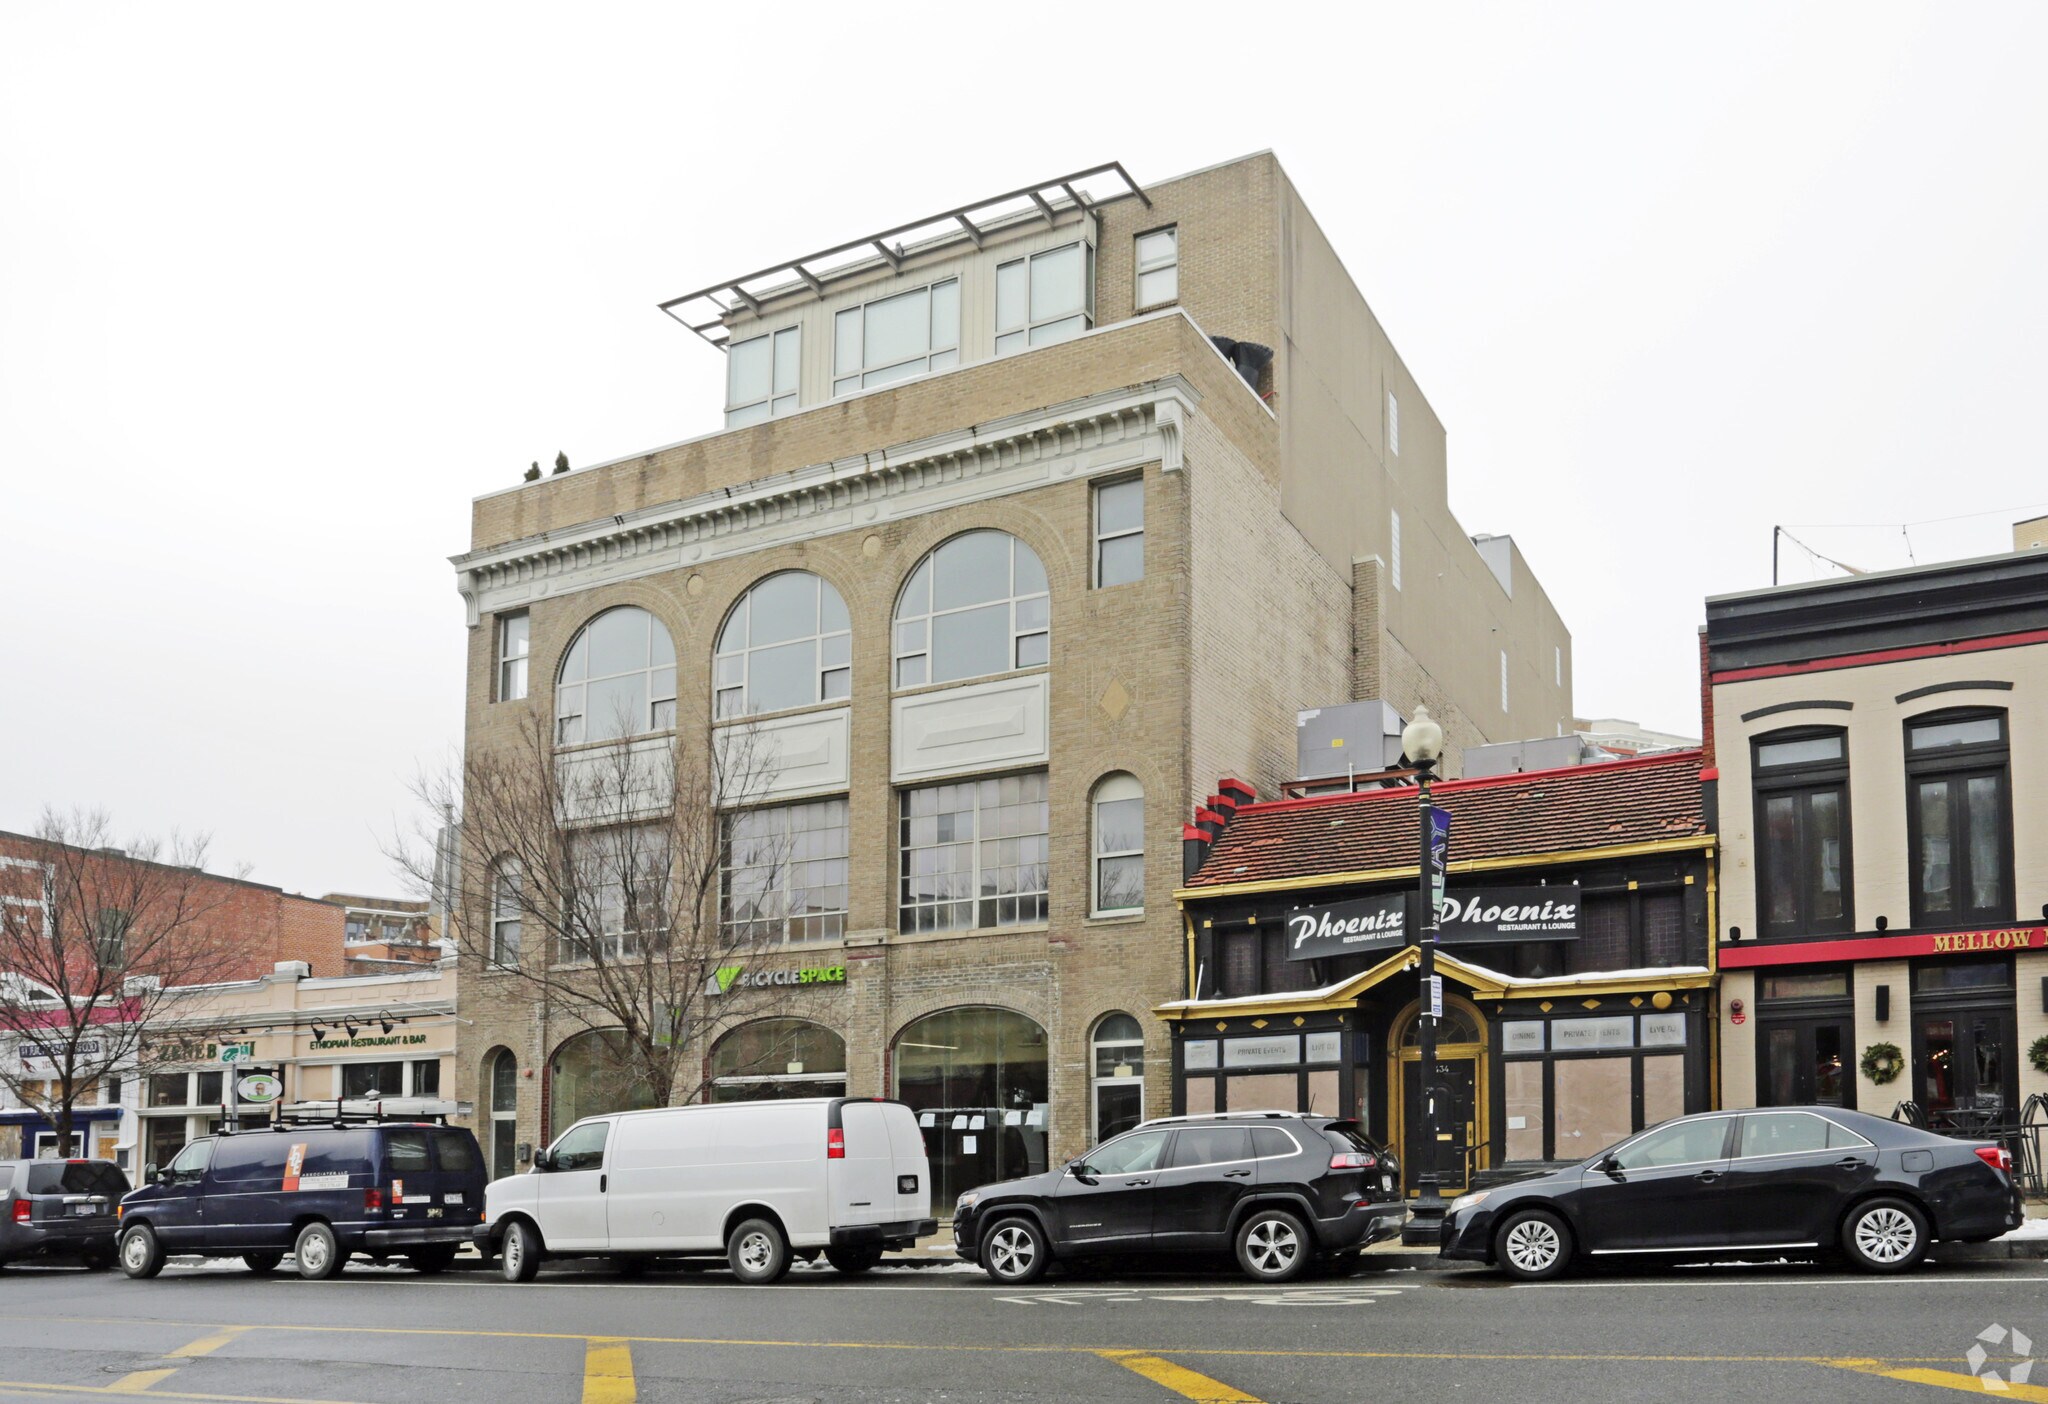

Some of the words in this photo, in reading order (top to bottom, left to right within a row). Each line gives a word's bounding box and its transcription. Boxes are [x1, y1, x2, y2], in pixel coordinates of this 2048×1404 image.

[1440, 896, 1576, 924] Phoenix
[1289, 909, 1404, 949] Phoenix
[1498, 923, 1542, 932] RESTAURANT
[1542, 922, 1547, 930] &
[1548, 922, 1576, 930] LOUNGE
[1342, 933, 1376, 944] RESTAURANT
[1376, 932, 1381, 940] &
[1381, 929, 1404, 940] LOUNGE
[1933, 930, 2033, 952] MELLOW
[1563, 1030, 1593, 1039] PRIVATE
[1650, 1025, 1666, 1034] LIVE
[1512, 1031, 1536, 1041] DINING
[309, 1039, 350, 1050] ETHIOPIAN
[351, 1036, 401, 1047] RESTAURANT
[402, 1035, 408, 1044] &
[409, 1034, 427, 1044] BAR
[1311, 1043, 1326, 1052] LIVE
[1237, 1047, 1262, 1056] PRIVATE
[1263, 1045, 1287, 1055] EVENTS
